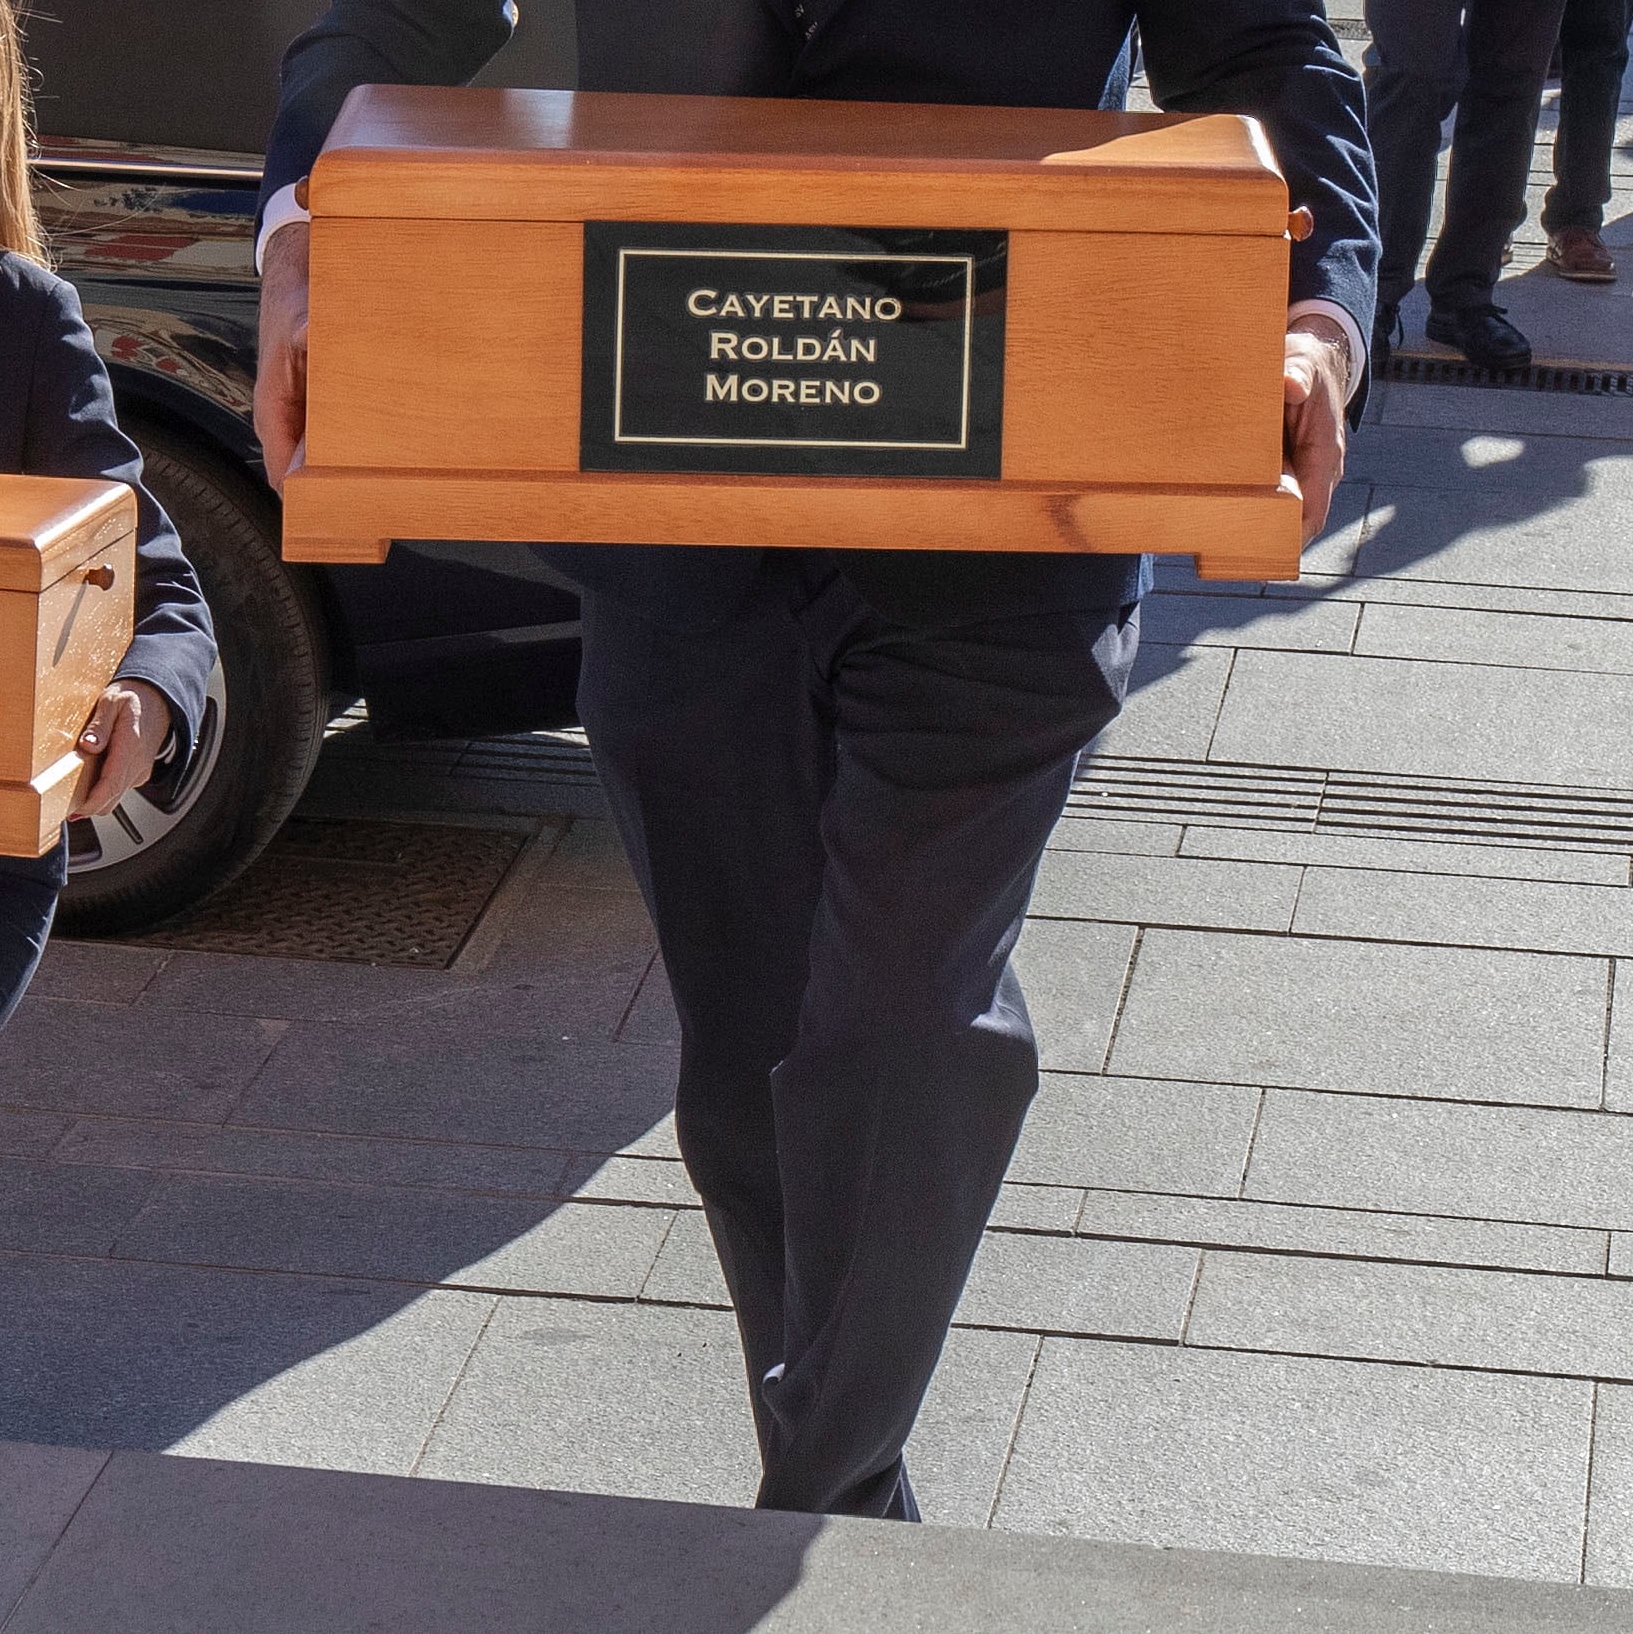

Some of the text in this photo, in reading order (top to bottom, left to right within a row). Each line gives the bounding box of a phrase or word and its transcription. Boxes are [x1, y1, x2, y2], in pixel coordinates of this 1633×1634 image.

[687, 289, 903, 321] CAYETANO
[709, 329, 876, 363] ROLDÁN
[704, 374, 881, 406] MORENO
